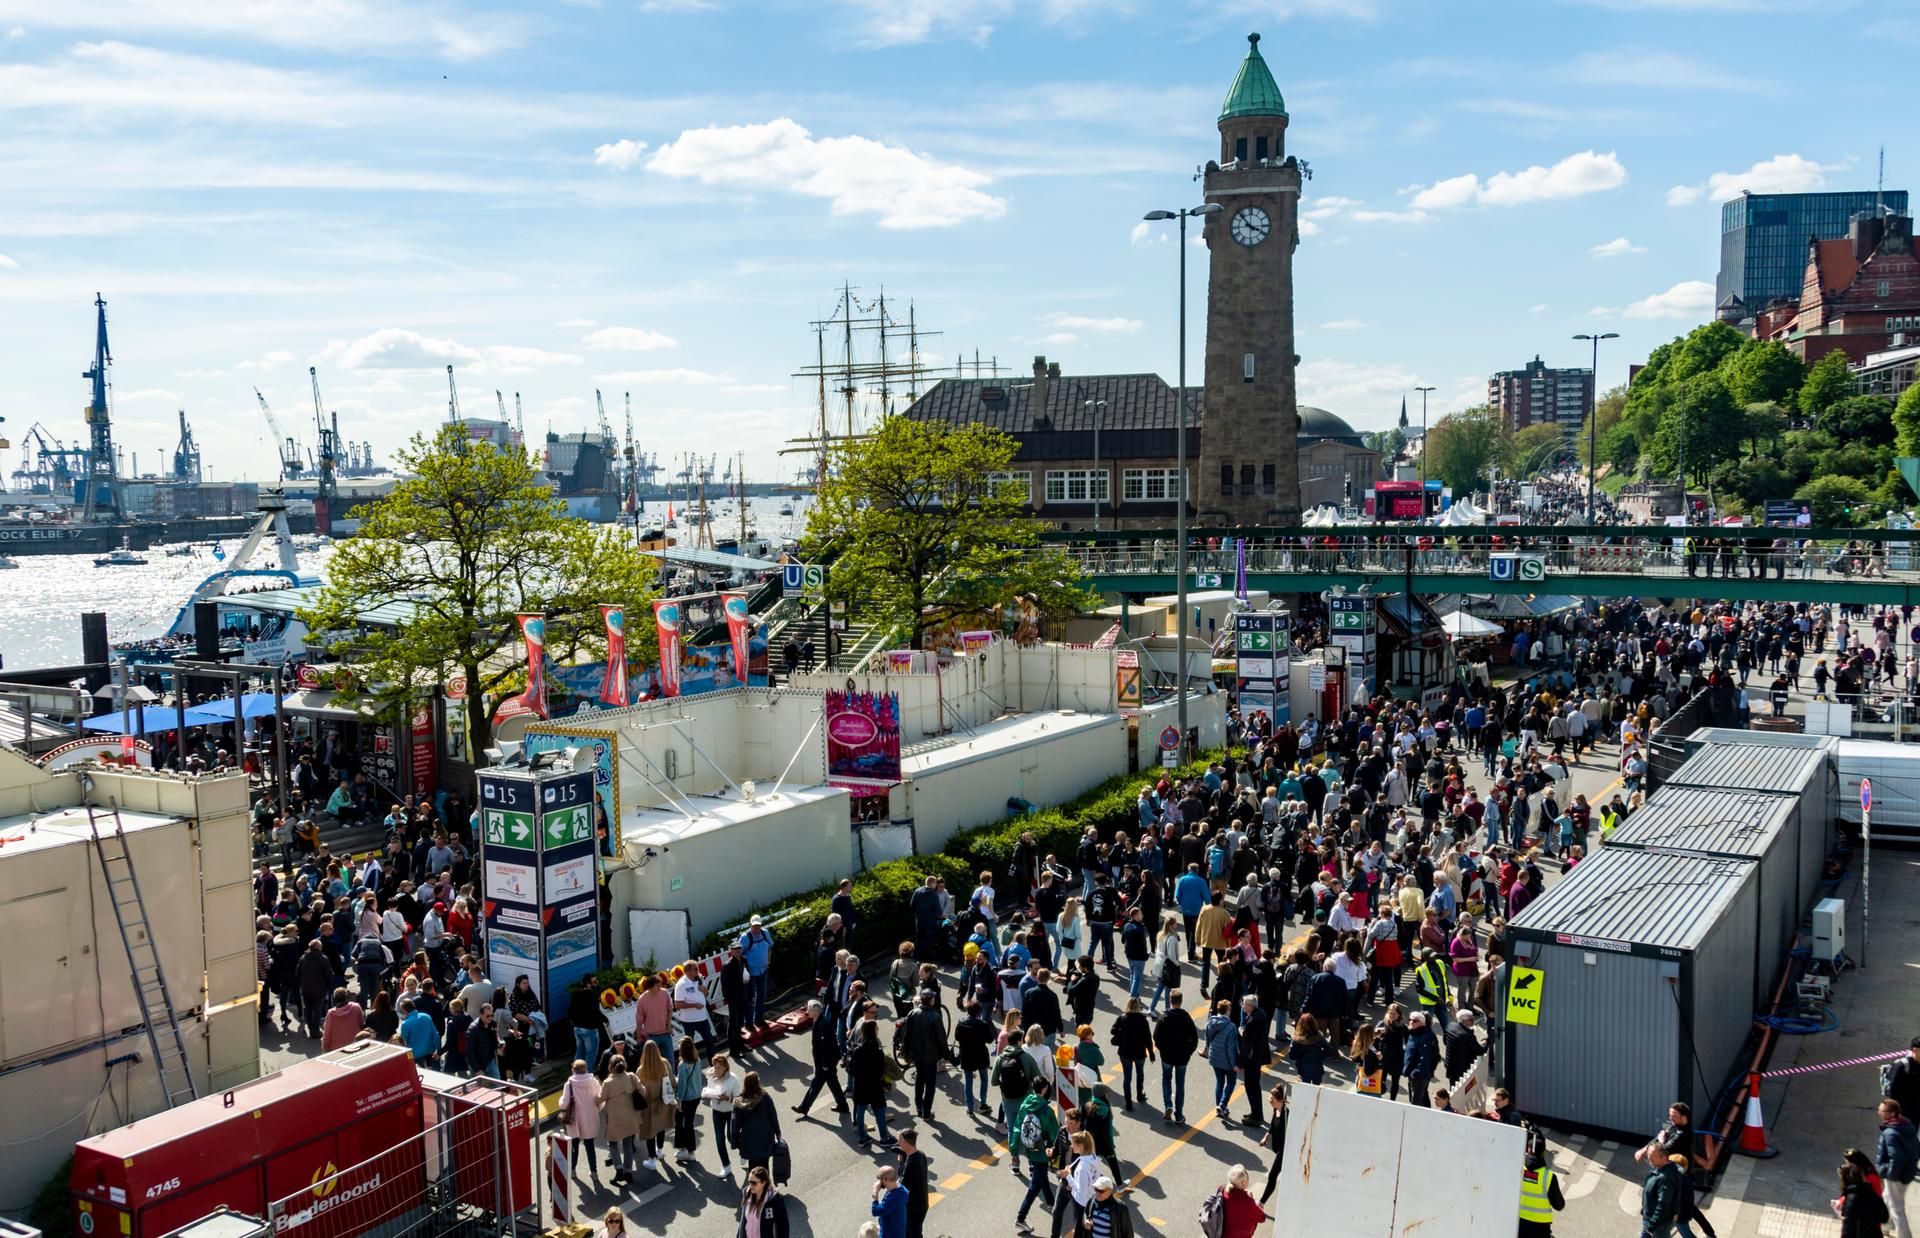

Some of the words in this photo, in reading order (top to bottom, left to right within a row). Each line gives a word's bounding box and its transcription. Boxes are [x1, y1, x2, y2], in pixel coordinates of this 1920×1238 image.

[32, 530, 64, 539] ELBE
[68, 530, 82, 538] 17
[785, 566, 800, 587] U
[807, 568, 820, 586] S
[1493, 559, 1511, 578] U
[1525, 561, 1540, 577] S
[1248, 619, 1261, 628] 14
[498, 786, 516, 805] 15
[560, 783, 576, 803] 15
[1511, 996, 1537, 1010] WC
[508, 1109, 524, 1121] HVE
[145, 1176, 181, 1198] 4745
[765, 1207, 774, 1219] H
